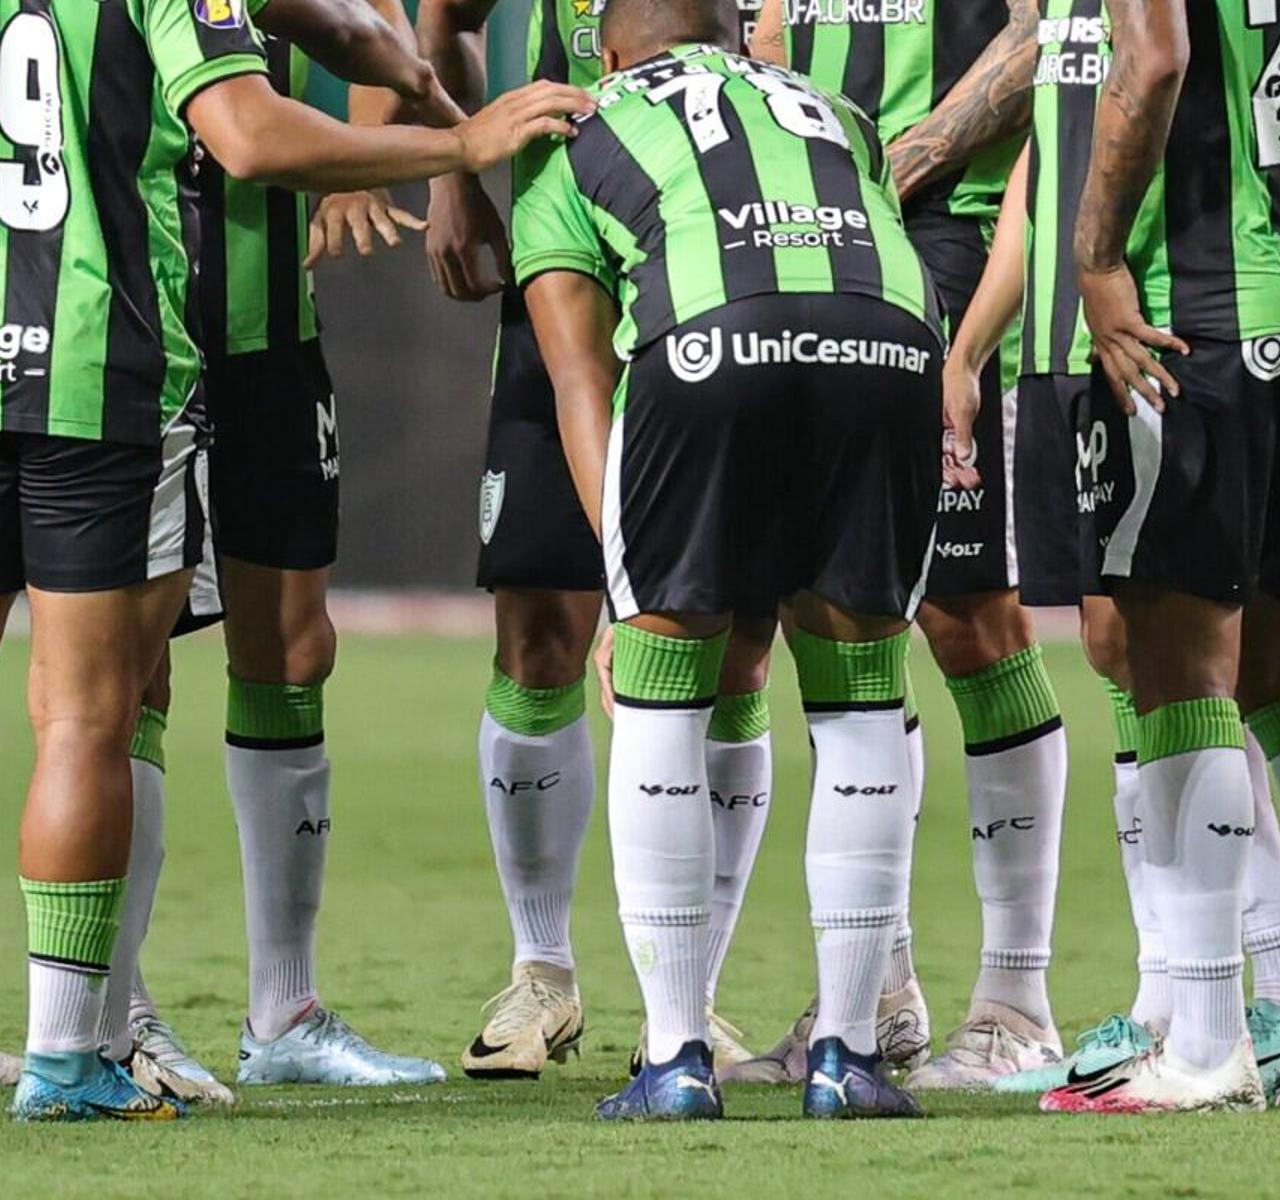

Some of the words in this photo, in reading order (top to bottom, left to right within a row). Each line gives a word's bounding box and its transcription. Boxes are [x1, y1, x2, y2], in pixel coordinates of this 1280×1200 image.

[719, 200, 868, 231] Village
[752, 230, 845, 249] Resort
[732, 330, 930, 375] UniCesumar
[489, 770, 561, 796] AFC
[295, 817, 331, 836] AF
[971, 815, 1036, 841] AFC
